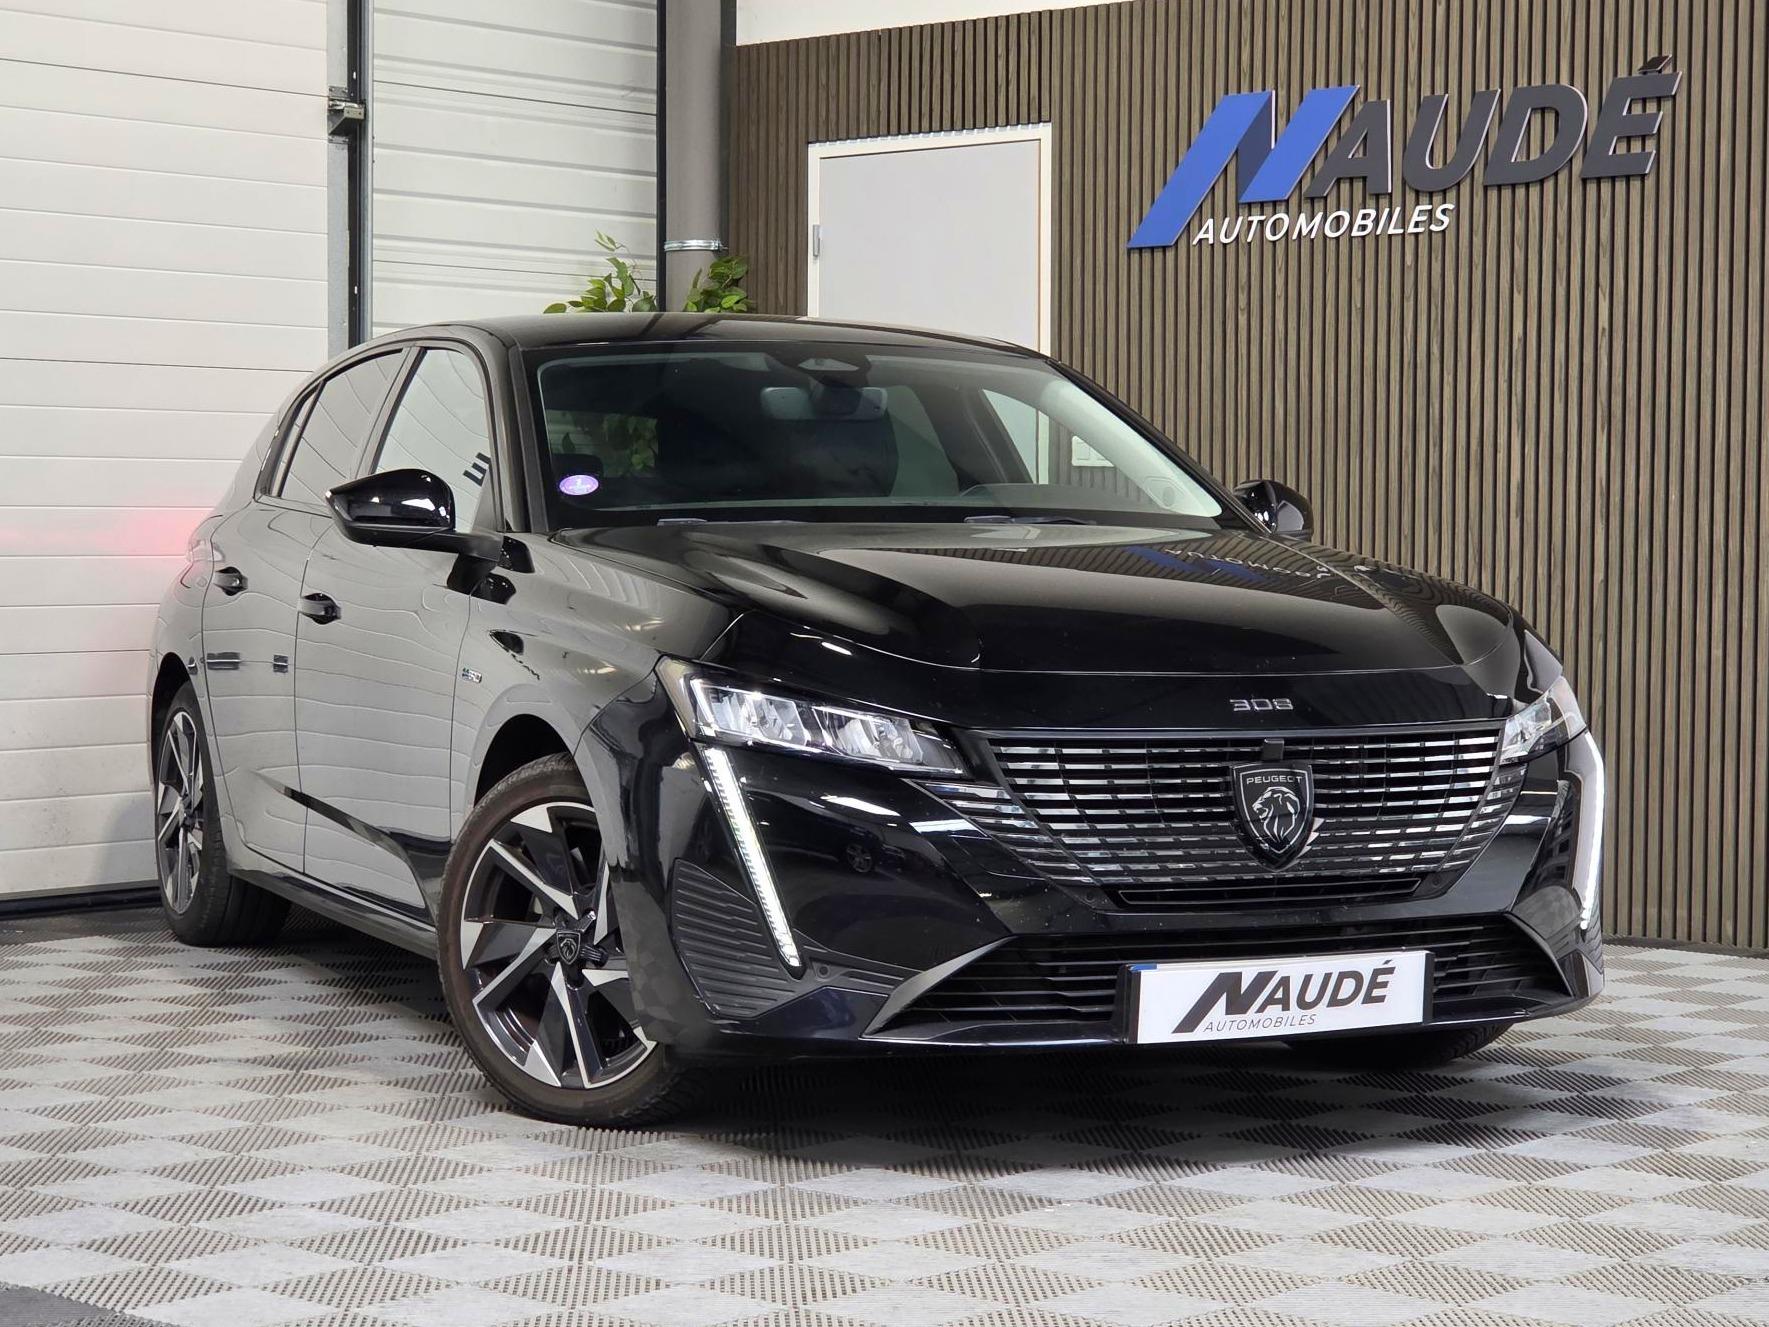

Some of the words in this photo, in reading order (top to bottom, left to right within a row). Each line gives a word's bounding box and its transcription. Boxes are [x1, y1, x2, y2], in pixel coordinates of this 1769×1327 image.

[1126, 54, 1683, 249] NAUDÉ
[1192, 203, 1455, 246] AUTOMOBILES
[1229, 698, 1294, 711] 308
[1246, 774, 1303, 785] PEUGEOT
[1171, 959, 1396, 1034] NAUDÉ
[1202, 1013, 1316, 1034] AUTOMOBILES
